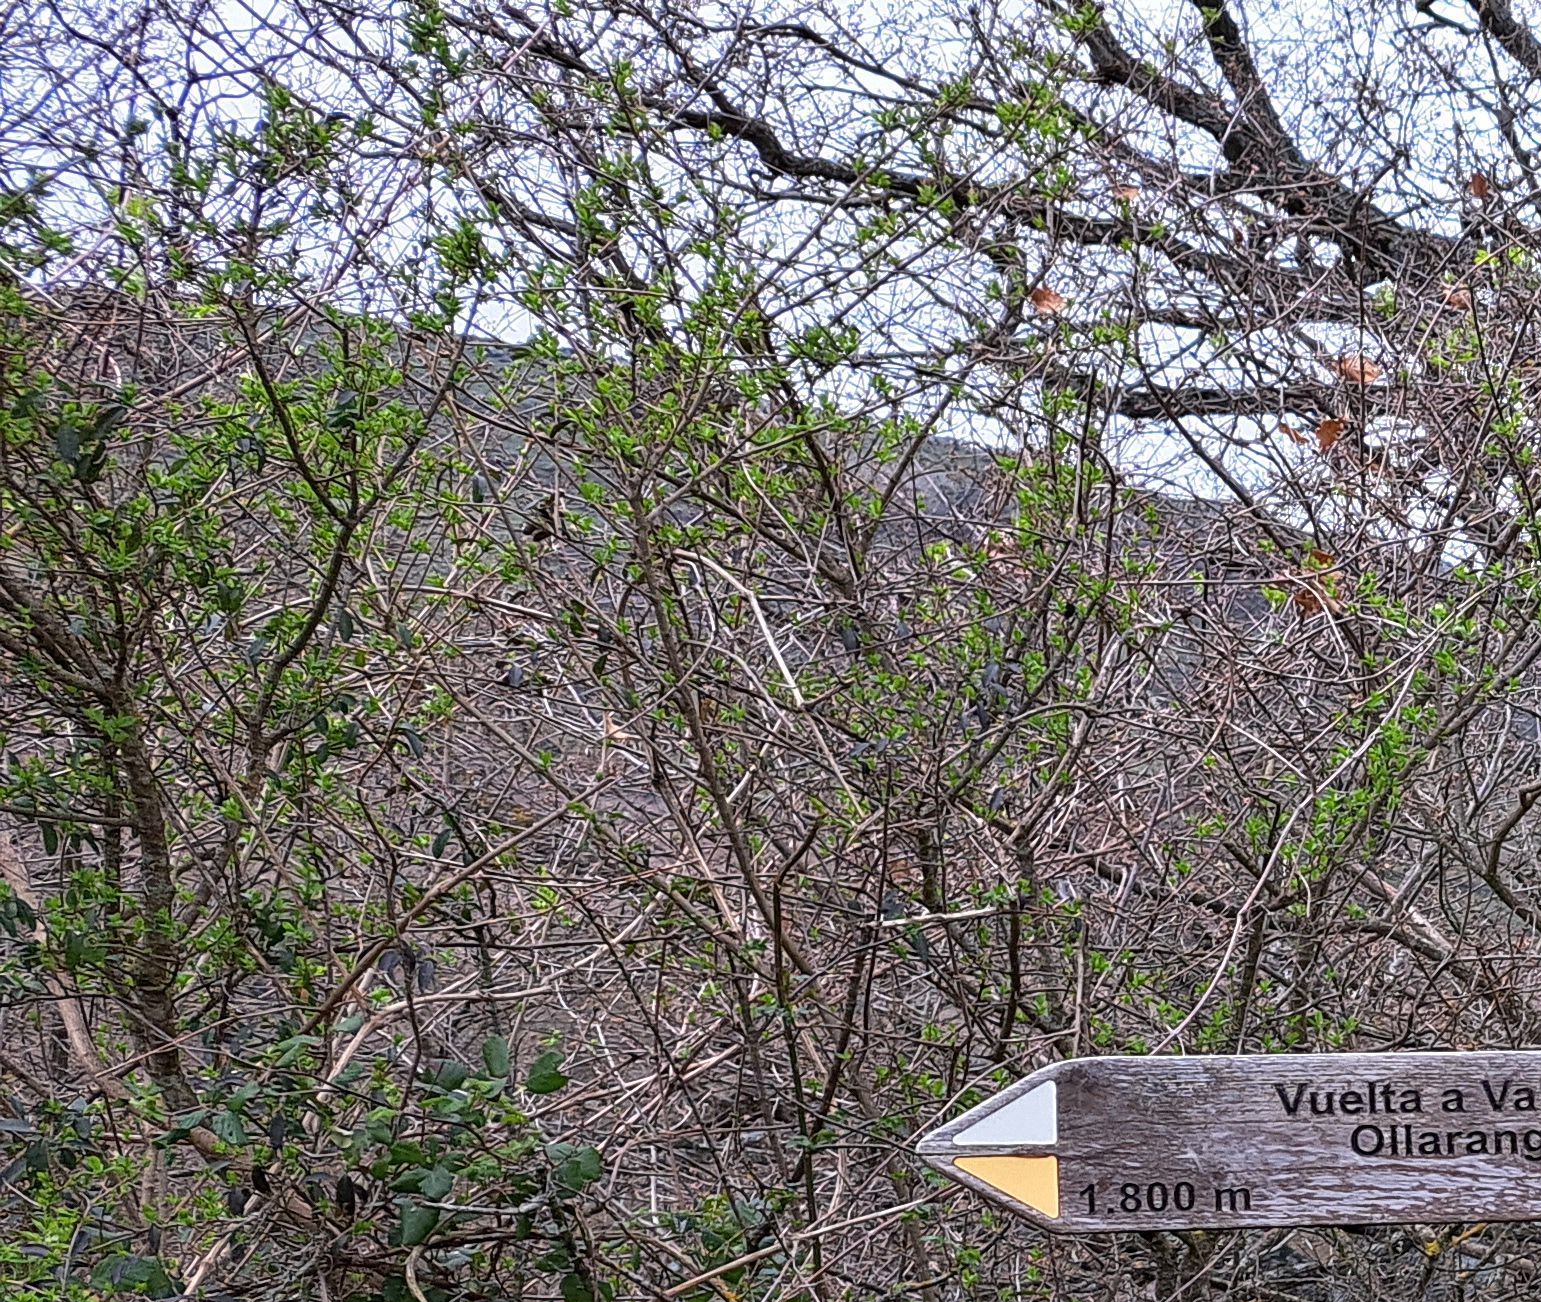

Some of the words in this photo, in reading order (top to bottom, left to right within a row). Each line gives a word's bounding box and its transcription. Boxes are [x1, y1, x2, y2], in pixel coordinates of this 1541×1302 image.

[1275, 1082, 1421, 1115] Vuelta
[1442, 1087, 1465, 1113] a
[1079, 1181, 1196, 1215] 1.800
[1214, 1186, 1252, 1213] m
